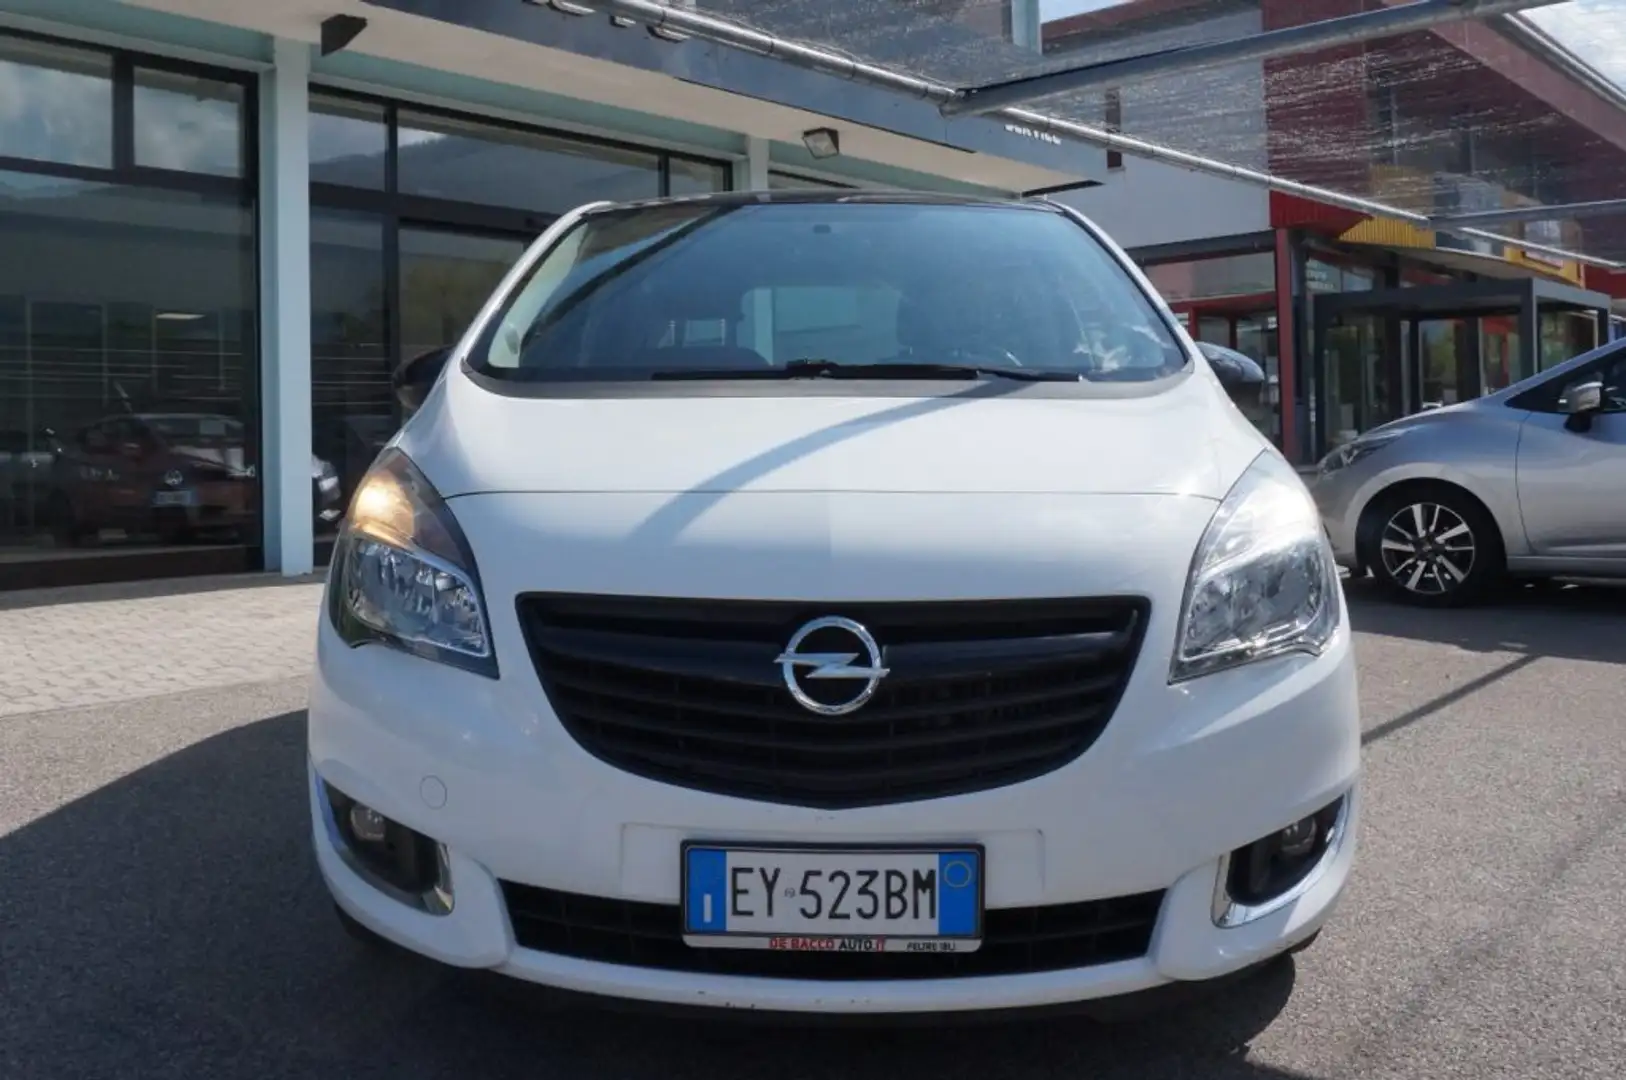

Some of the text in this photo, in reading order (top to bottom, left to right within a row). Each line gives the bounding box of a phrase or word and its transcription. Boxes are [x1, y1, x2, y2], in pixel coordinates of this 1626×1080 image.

[731, 867, 937, 920] EY 523BM
[791, 937, 835, 950] BACCO
